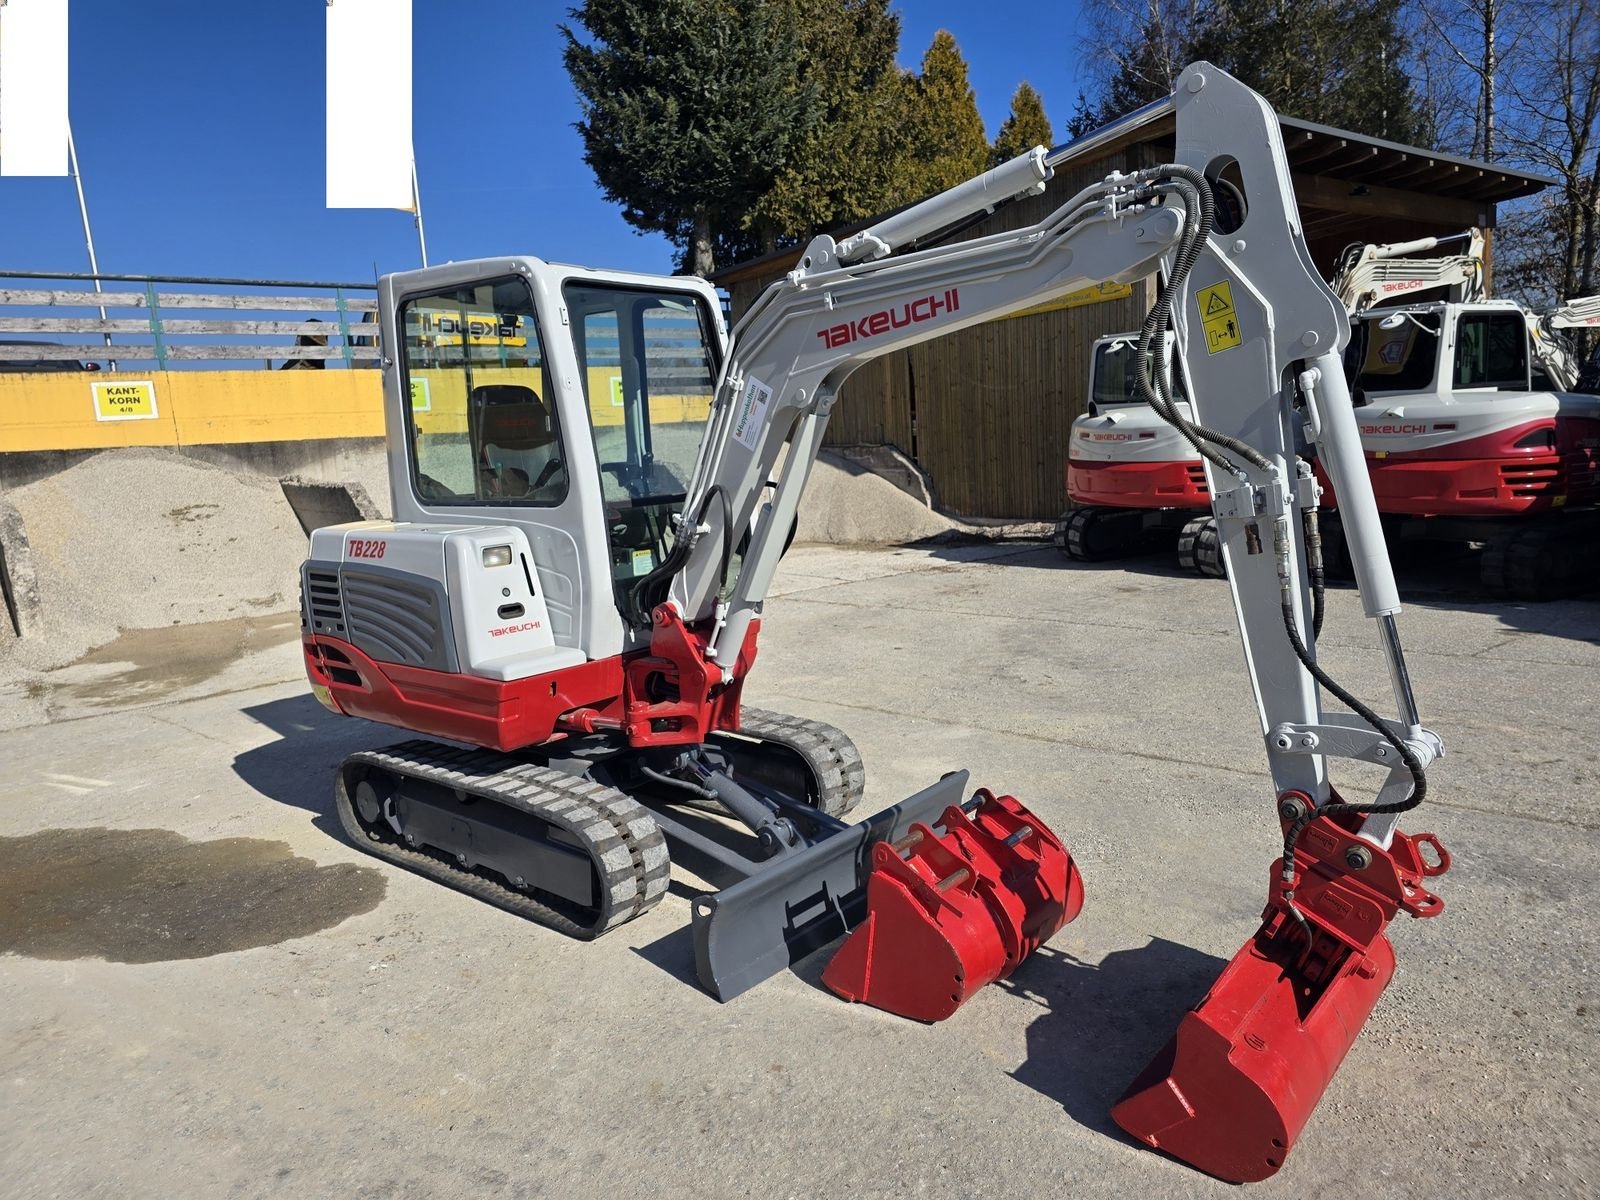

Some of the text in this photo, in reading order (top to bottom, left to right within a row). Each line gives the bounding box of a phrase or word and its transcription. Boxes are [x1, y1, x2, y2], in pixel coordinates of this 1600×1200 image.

[106, 387, 140, 395] KANT-
[109, 397, 141, 405] KORN
[348, 540, 386, 559] TB228
